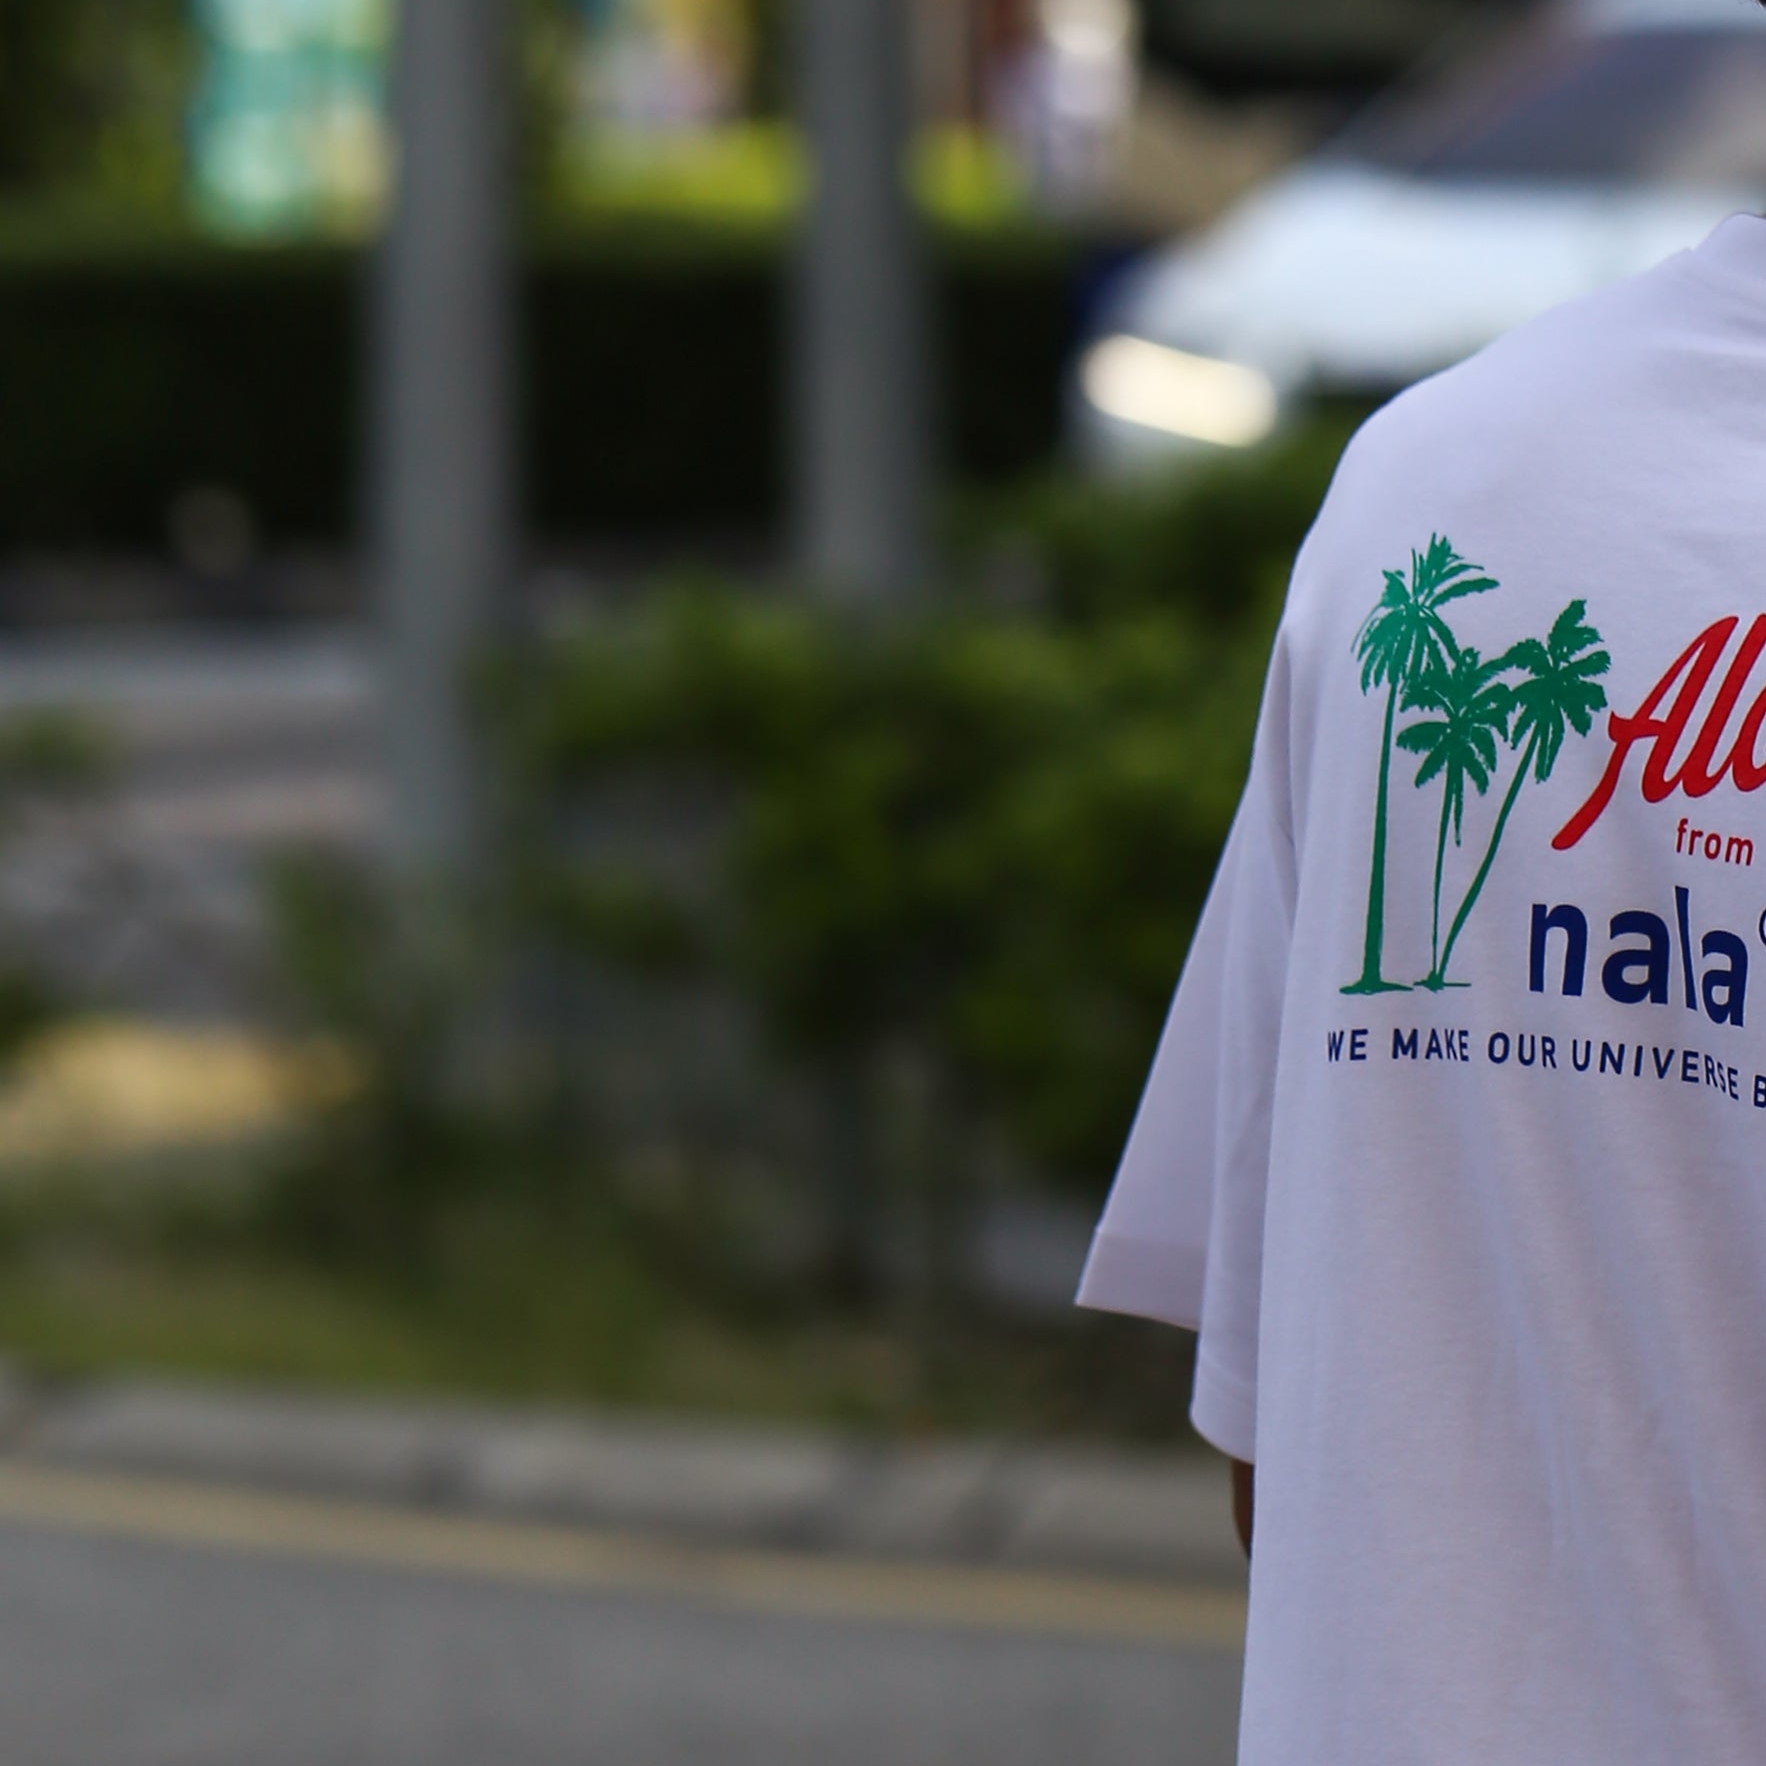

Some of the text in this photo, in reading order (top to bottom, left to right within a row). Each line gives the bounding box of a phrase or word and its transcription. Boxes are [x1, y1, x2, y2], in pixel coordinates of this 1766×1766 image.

[1675, 818, 1754, 867] from
[1326, 1028, 1369, 1063] WE
[1390, 1028, 1470, 1063] MAKE
[1487, 1031, 1558, 1071] OUR
[1571, 1040, 1739, 1101] UNIVERSE
